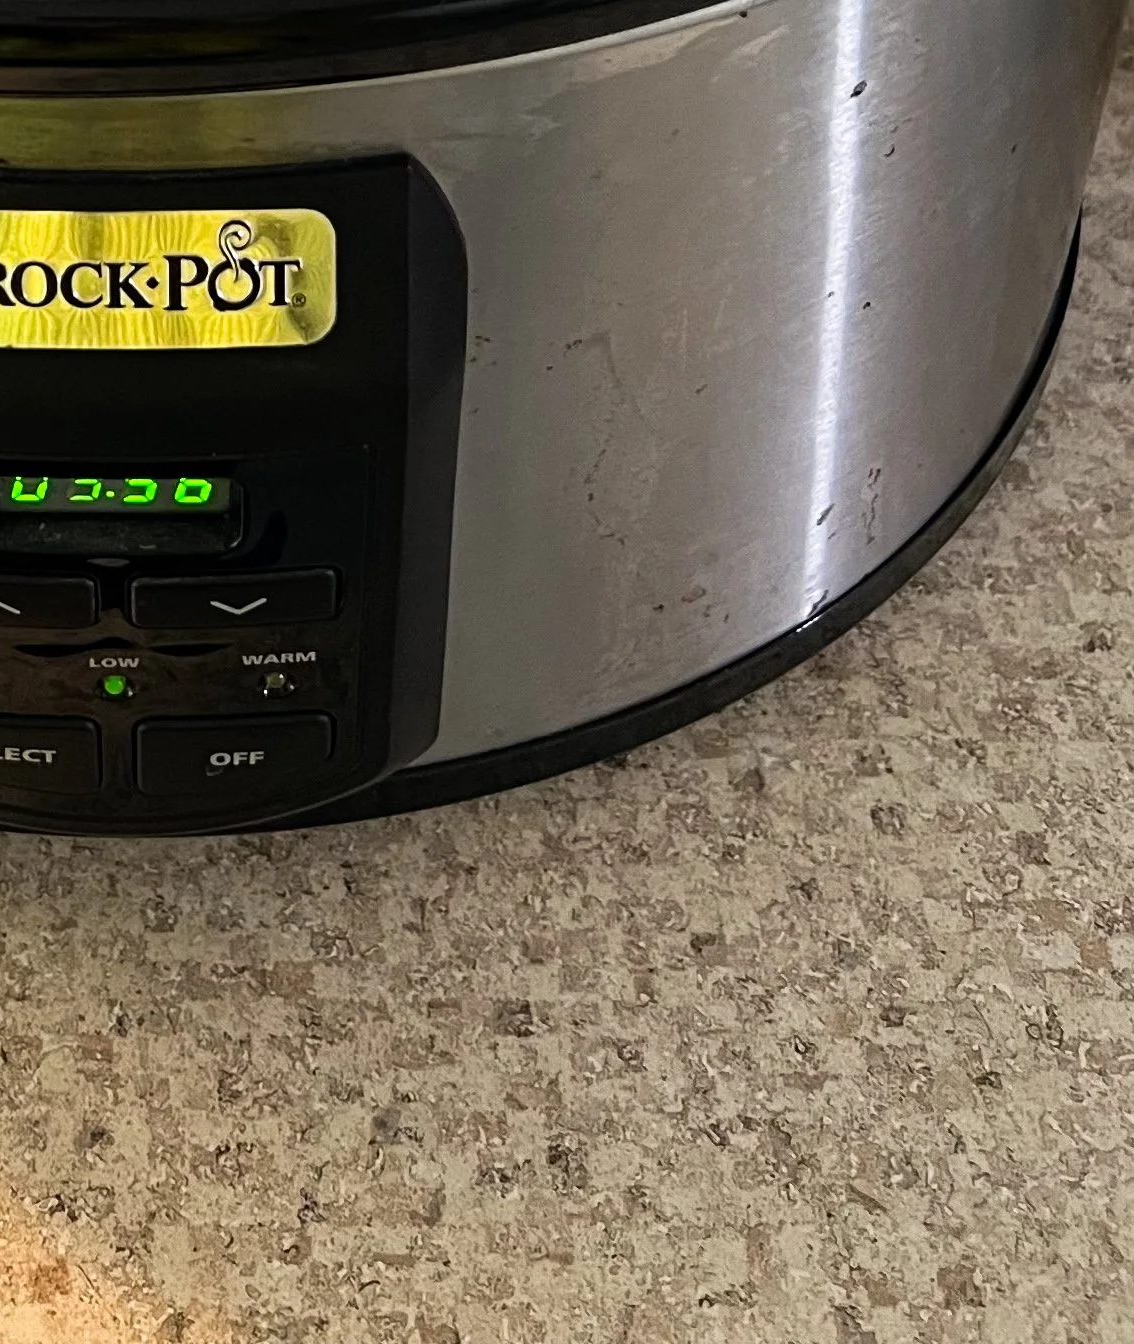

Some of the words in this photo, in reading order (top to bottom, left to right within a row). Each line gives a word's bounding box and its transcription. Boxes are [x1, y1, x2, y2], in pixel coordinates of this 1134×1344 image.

[88, 657, 141, 669] LOW
[241, 650, 317, 666] WARM
[209, 750, 265, 767] OFF
